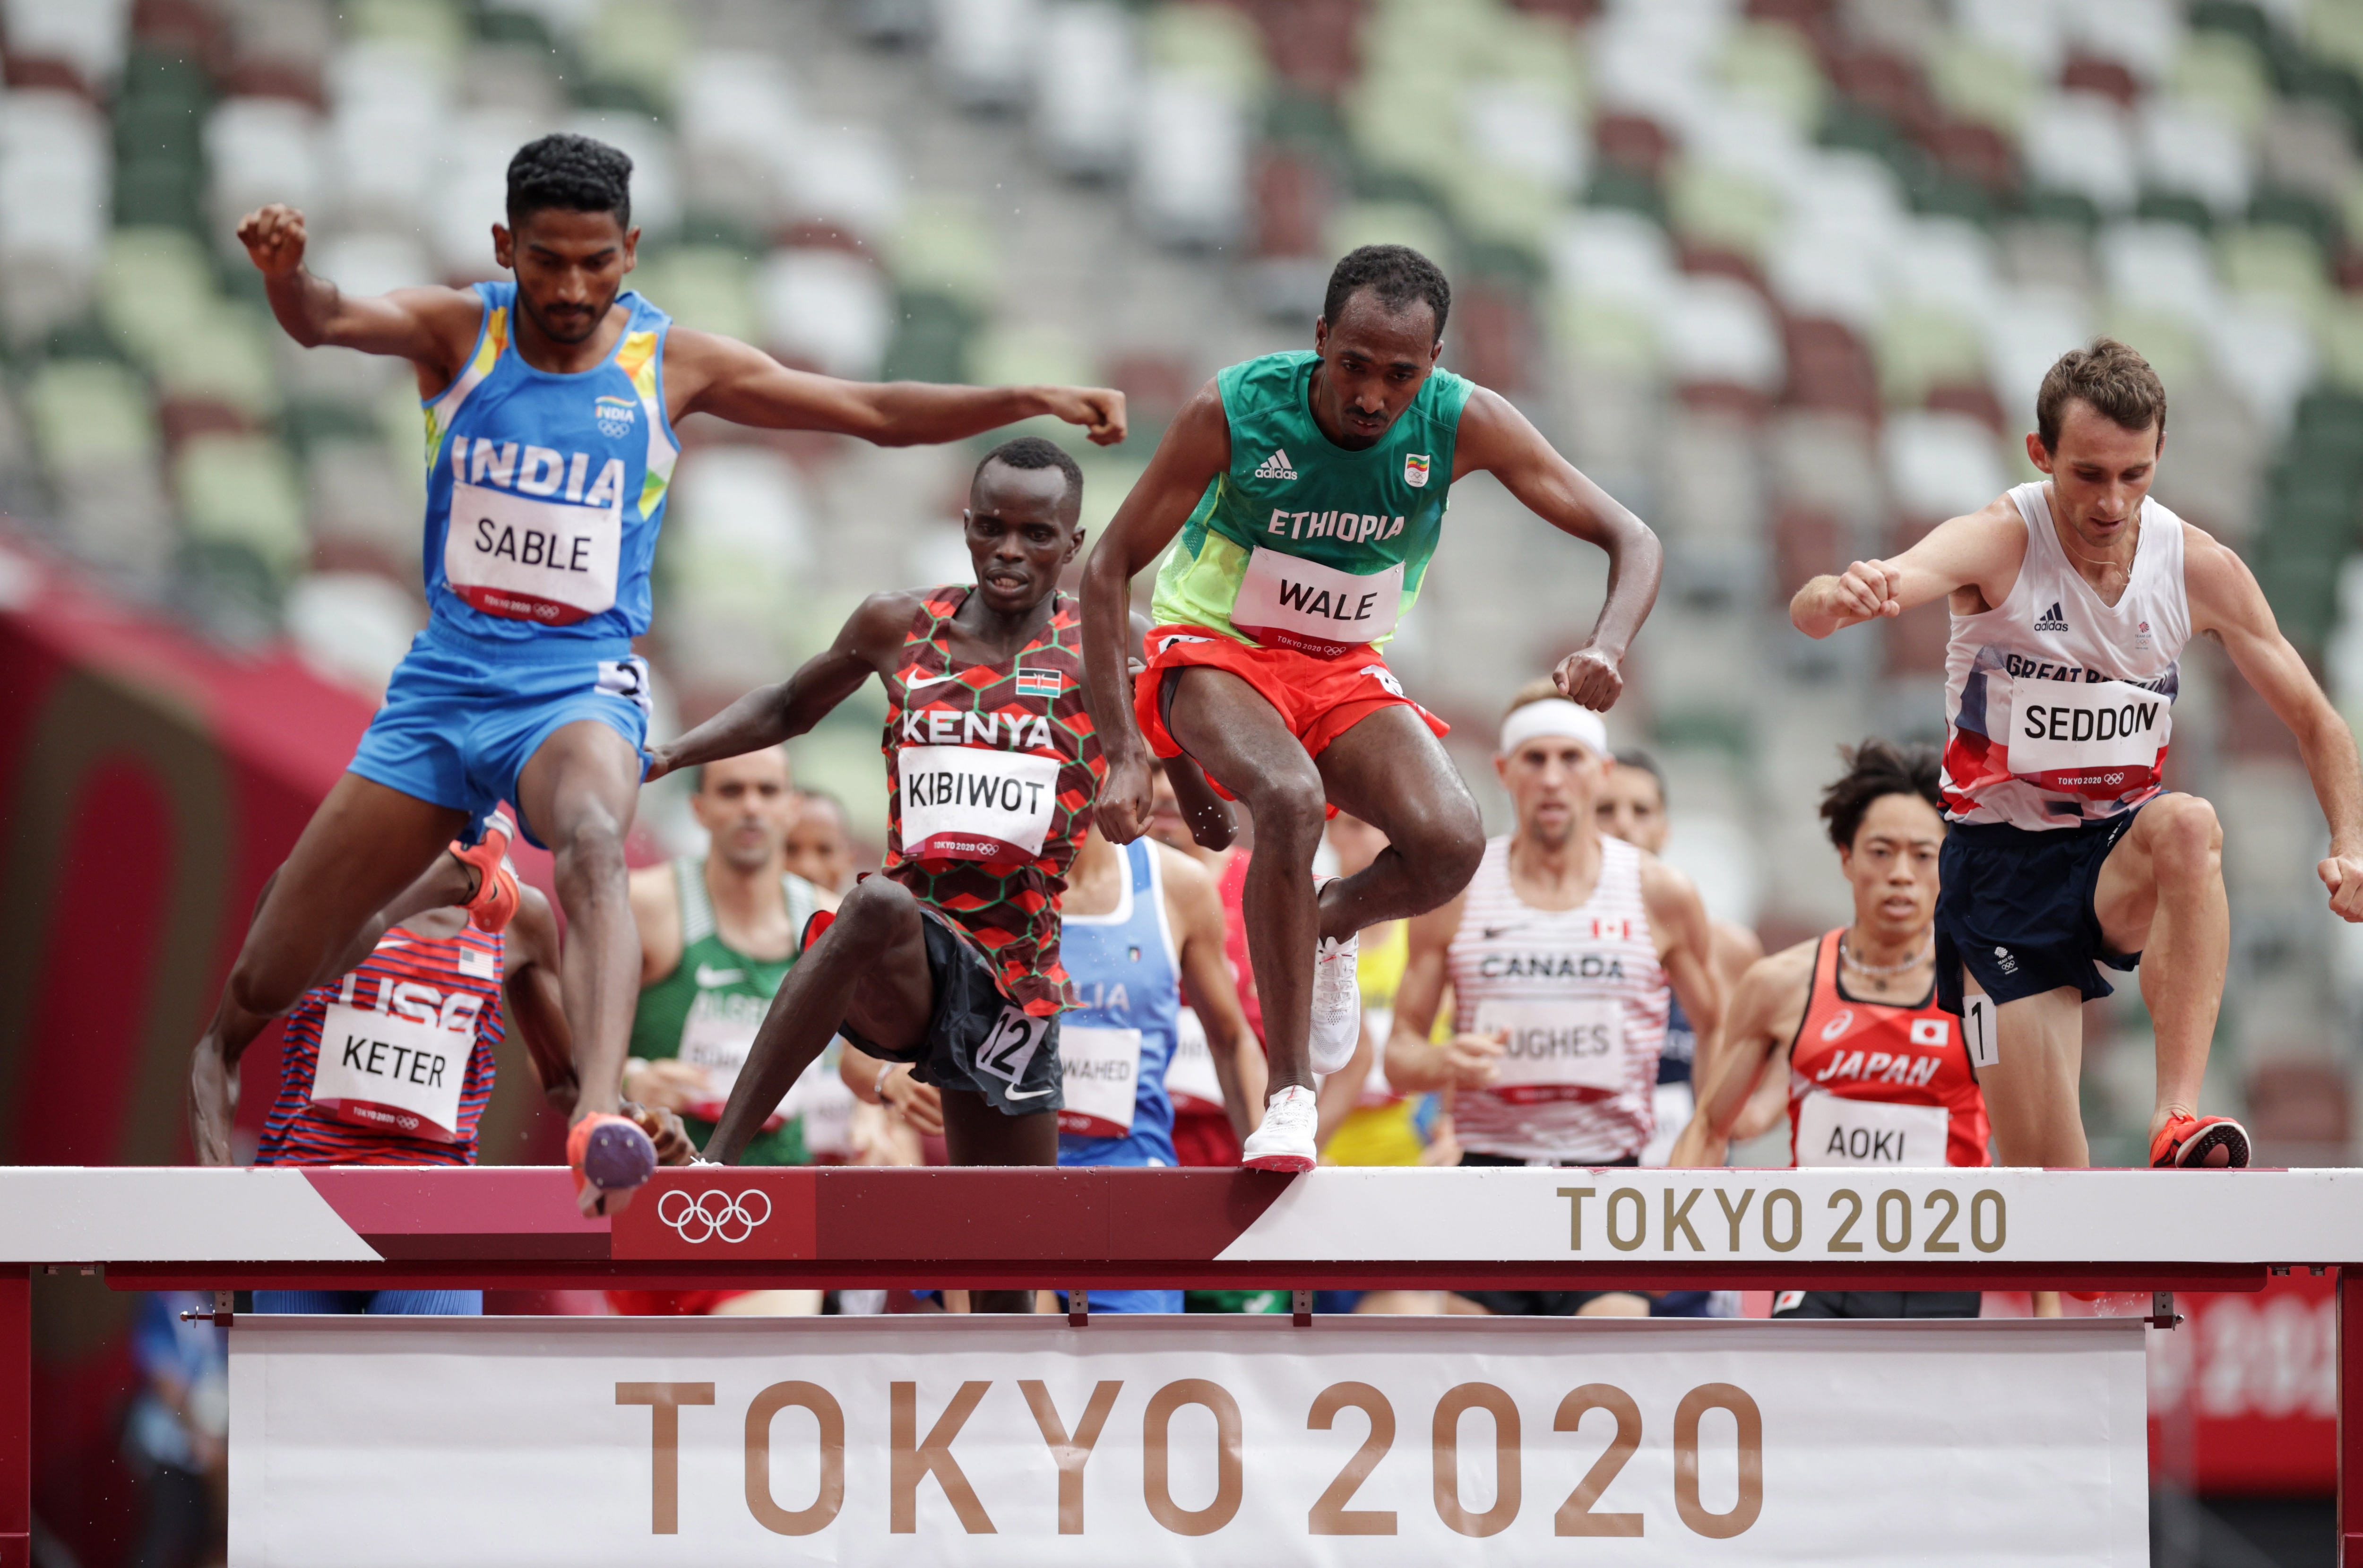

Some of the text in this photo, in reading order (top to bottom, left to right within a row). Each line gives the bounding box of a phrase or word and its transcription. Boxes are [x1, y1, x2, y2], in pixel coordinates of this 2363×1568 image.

[595, 405, 635, 423] INDIA
[450, 434, 625, 509] INDIA
[1255, 467, 1298, 480] adidas
[1268, 508, 1405, 543] ETHIOPIA
[474, 517, 592, 572] SABLE
[1279, 578, 1378, 621] WALE
[1277, 635, 1322, 652] TOKYO 2020
[2034, 620, 2069, 632] adidas
[902, 709, 1055, 750] KENYA
[2024, 702, 2159, 741] SEDDON
[908, 772, 1045, 815] KIBIWOT
[2058, 776, 2102, 785] TOKYO 2020
[933, 841, 975, 852] TOKYO 2020
[1479, 954, 1626, 980] CANADA
[338, 972, 485, 1034] USA
[981, 1012, 1032, 1076] 12
[1484, 1023, 1610, 1059] UGHES
[1971, 1001, 1984, 1060] 1
[342, 1035, 445, 1088] KETER
[1062, 1058, 1131, 1081] WAHED
[1816, 1050, 1941, 1087] JAPAN
[354, 1106, 377, 1120] TOKYO
[1827, 1125, 1906, 1162] AOKI
[1557, 1187, 2007, 1254] TOKYO 2020
[615, 1378, 1763, 1539] TOKYO 2020
